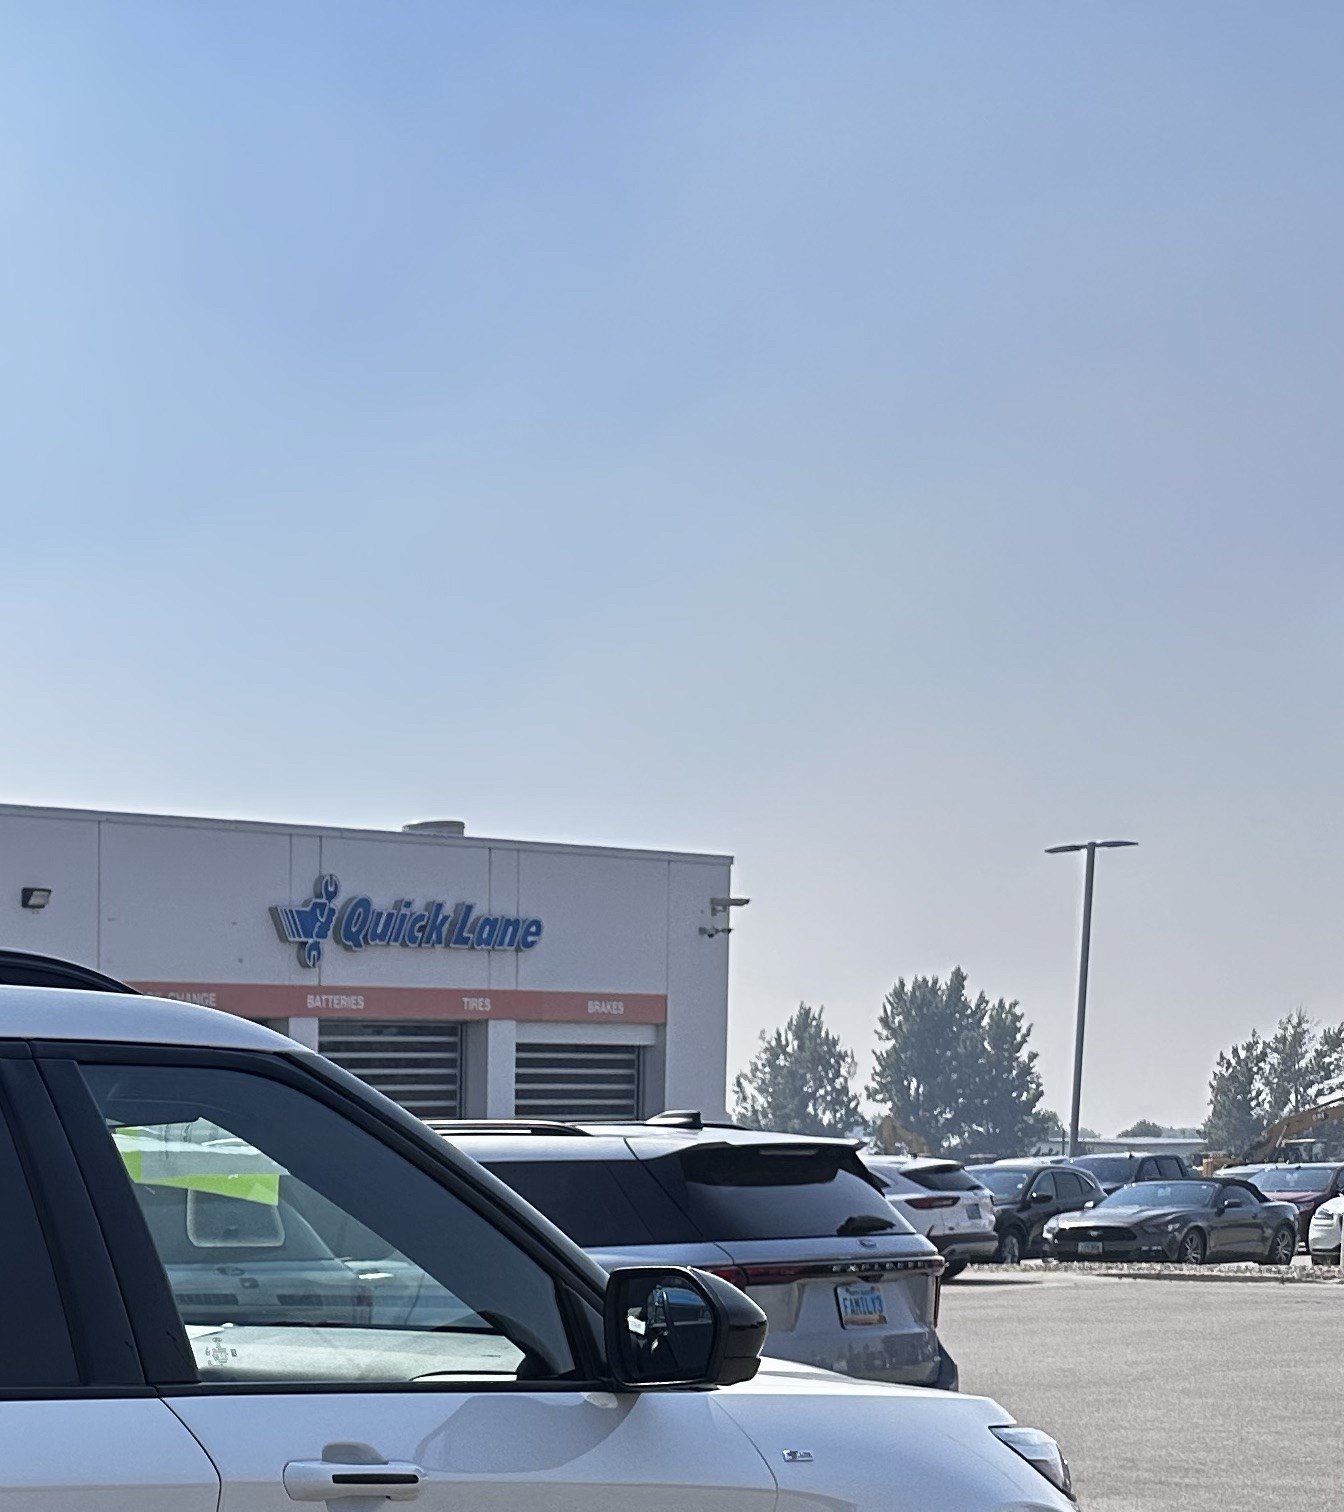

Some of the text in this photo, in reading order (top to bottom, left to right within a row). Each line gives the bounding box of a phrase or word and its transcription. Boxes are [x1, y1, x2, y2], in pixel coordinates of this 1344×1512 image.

[306, 994, 365, 1010] BATTERIES
[462, 997, 491, 1011] TIRES
[587, 1000, 625, 1014] BRAKES
